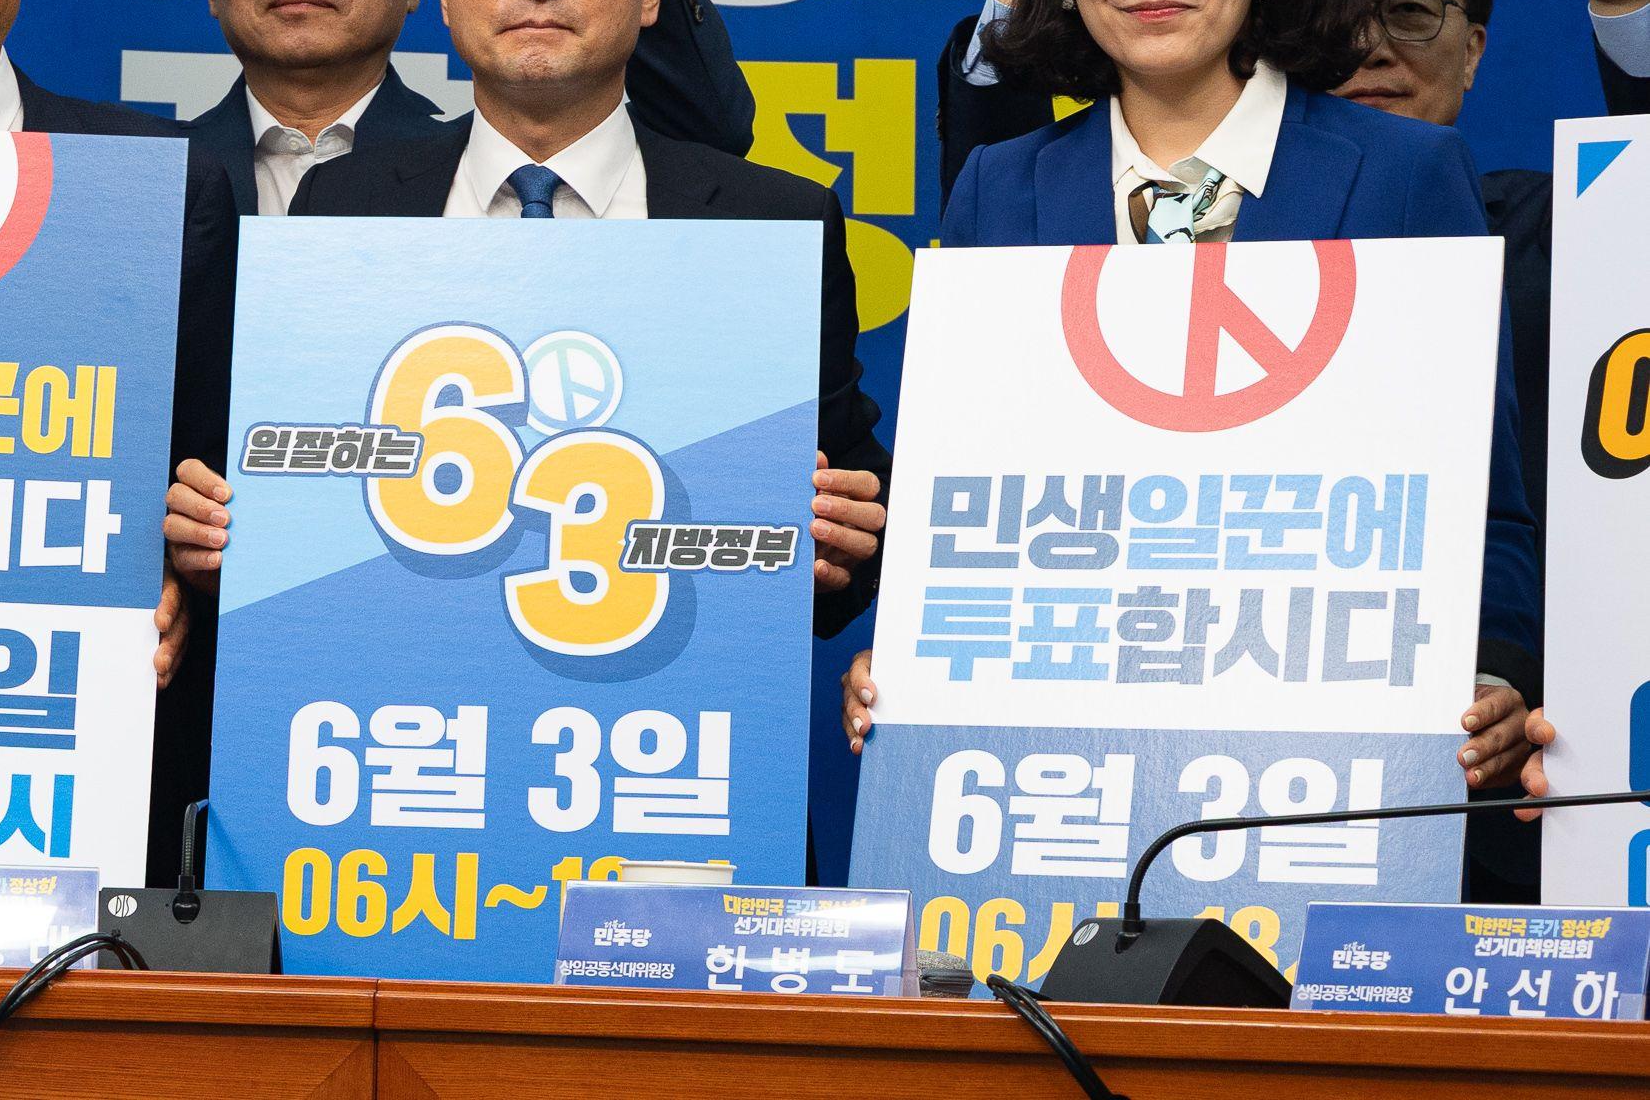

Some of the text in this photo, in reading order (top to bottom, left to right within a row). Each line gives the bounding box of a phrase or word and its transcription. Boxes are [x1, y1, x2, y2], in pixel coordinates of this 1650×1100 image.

[243, 425, 421, 473] 일잘하는
[367, 321, 668, 656] 6 3
[929, 472, 1429, 571] 민생일꾼에
[625, 524, 798, 569] 지방정부
[915, 585, 1431, 687] 투표합시다
[286, 700, 732, 837] 6월 3일
[928, 749, 1384, 886] 6월 3일
[9, 875, 58, 895] 정상화
[723, 894, 784, 916] 대한민국
[594, 928, 652, 947] 민주당
[734, 916, 850, 938] 선거대책위원회
[1465, 914, 1613, 939] 대한민국 국가 정상화
[1332, 950, 1391, 970] 민주당
[1475, 938, 1593, 960] 선거대책위원회
[559, 960, 675, 979] 상임공동선대위원장
[1296, 984, 1413, 1003] 상임공동선대위원장
